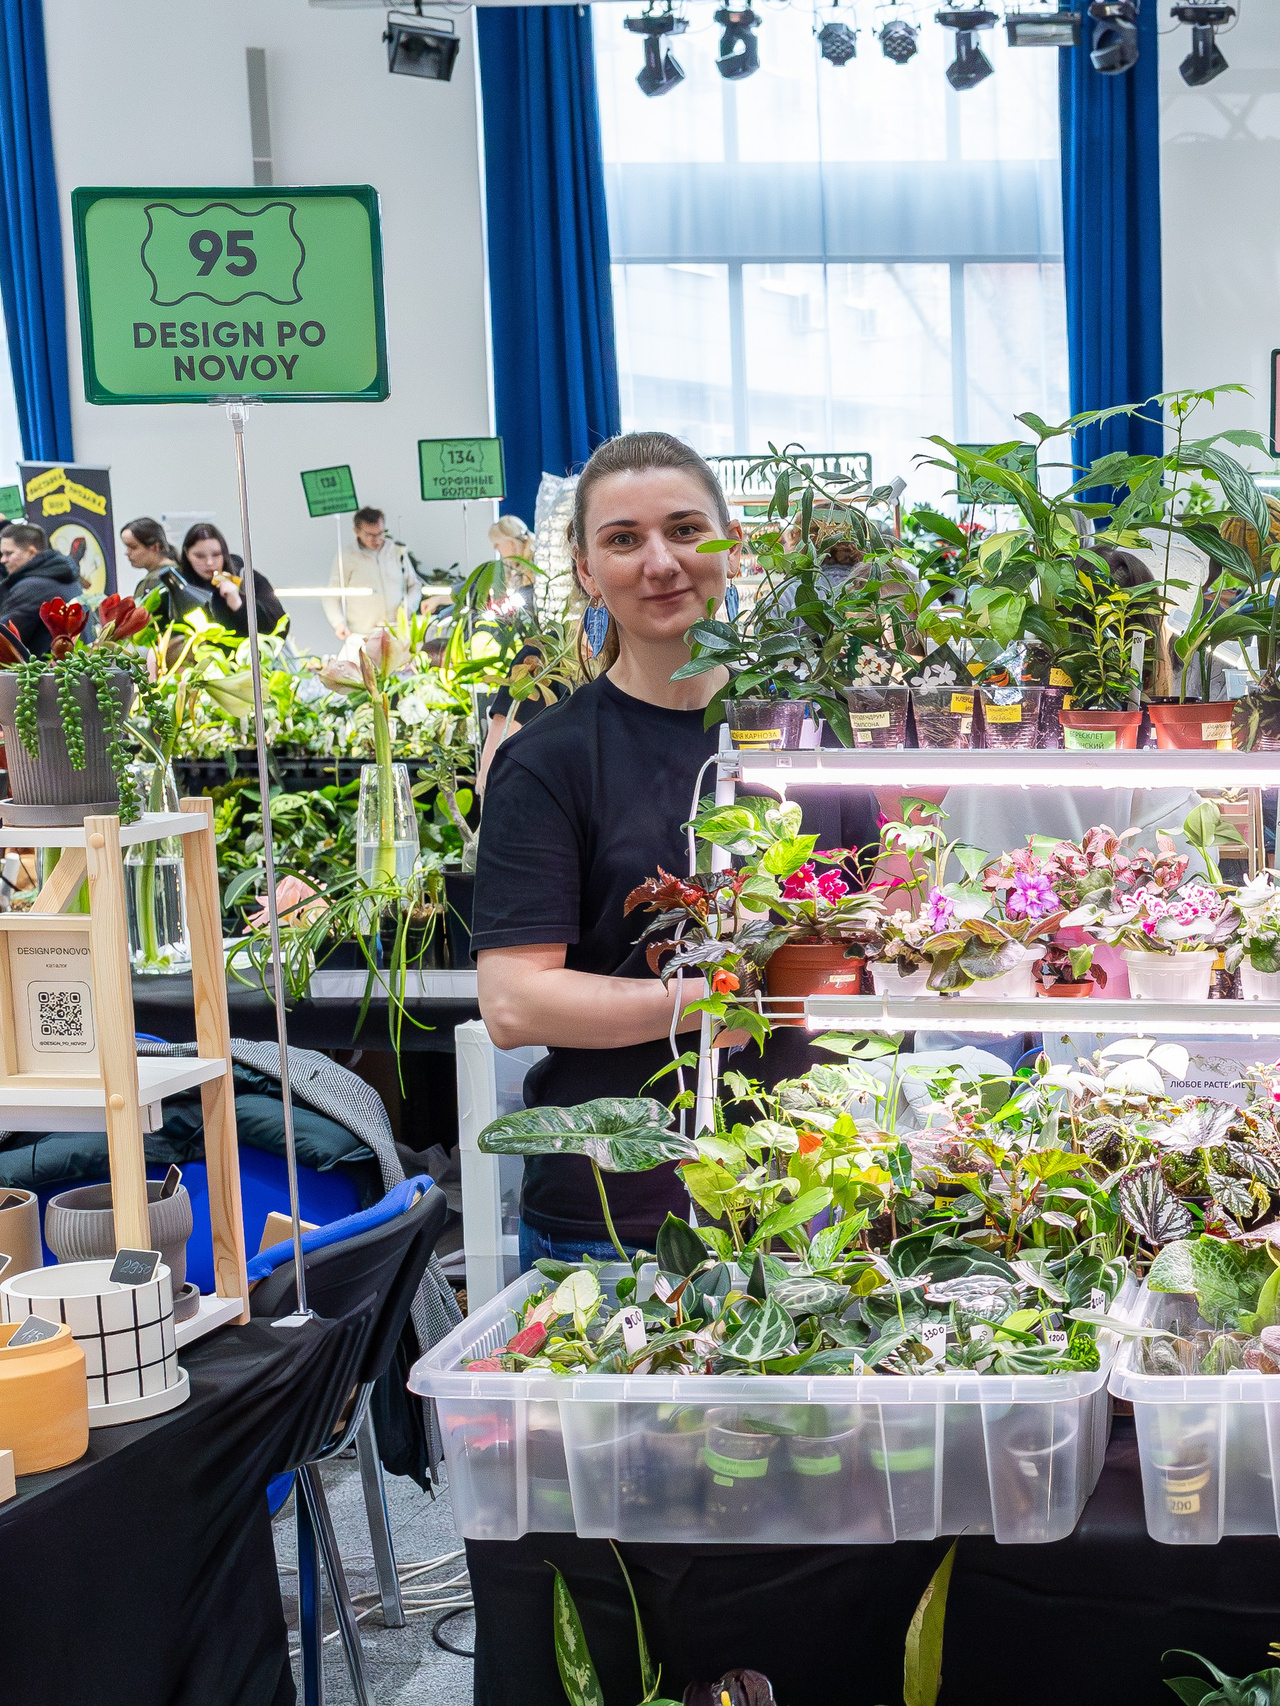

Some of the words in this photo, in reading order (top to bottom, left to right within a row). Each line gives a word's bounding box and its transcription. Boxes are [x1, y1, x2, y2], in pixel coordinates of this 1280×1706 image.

[188, 229, 258, 277] 95
[133, 320, 265, 349] DESIGN
[278, 320, 326, 347] PO
[173, 354, 300, 382] NOVOY
[447, 450, 476, 465] 134
[432, 475, 495, 486] ТОРФЯНЫЕ
[744, 731, 778, 740] КАРНОЗА
[1169, 1080, 1202, 1090] ЛЮБОЕ
[626, 1310, 642, 1329] 900
[924, 1325, 945, 1343] 3300
[1048, 1332, 1066, 1343] 1200
